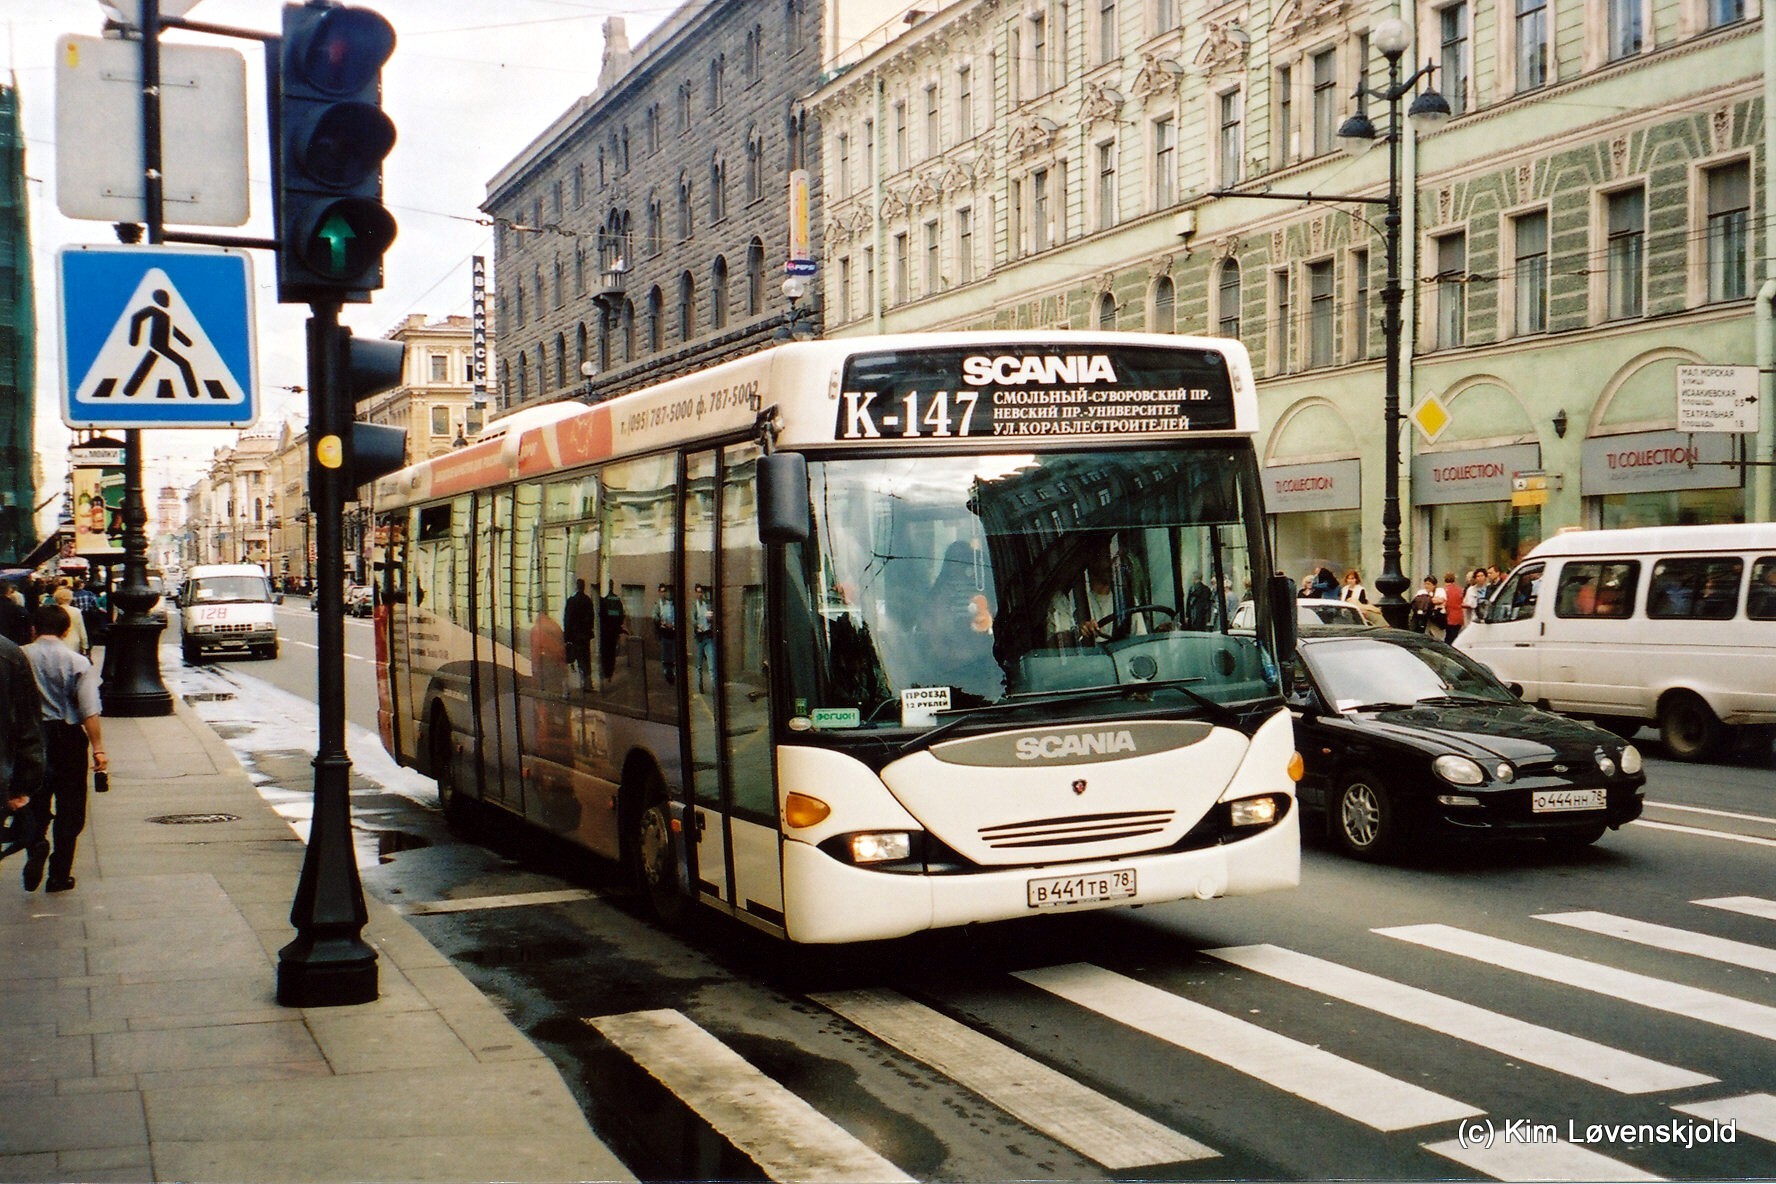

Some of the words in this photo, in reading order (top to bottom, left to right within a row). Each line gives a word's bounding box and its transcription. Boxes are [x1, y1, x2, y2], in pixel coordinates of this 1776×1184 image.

[474, 261, 486, 386] АВИАКАССЫ
[962, 355, 1118, 386] SCANIA
[993, 387, 1187, 404] СМОЛЬНЫЙ-СУВОРОВСКИЙ
[1190, 389, 1212, 400] ПР.
[650, 399, 693, 428] 787-5000
[843, 390, 979, 438] К-147
[993, 405, 1058, 419] НЕВСКИЙ
[1062, 404, 1180, 418] ПР.-УНИВЕРСИТЕТ
[993, 415, 1190, 436] УЛ.КОРАБЛЕСТРОИТЕЛЕЙ
[1618, 447, 1699, 468] COLLECTION
[1443, 463, 1504, 482] COLLECTION
[200, 607, 228, 620] 128
[905, 690, 947, 699] ПРОЕЗД
[1016, 730, 1137, 760] SCANIA
[1037, 879, 1108, 901] В441ТВ
[1113, 872, 1129, 888] 78
